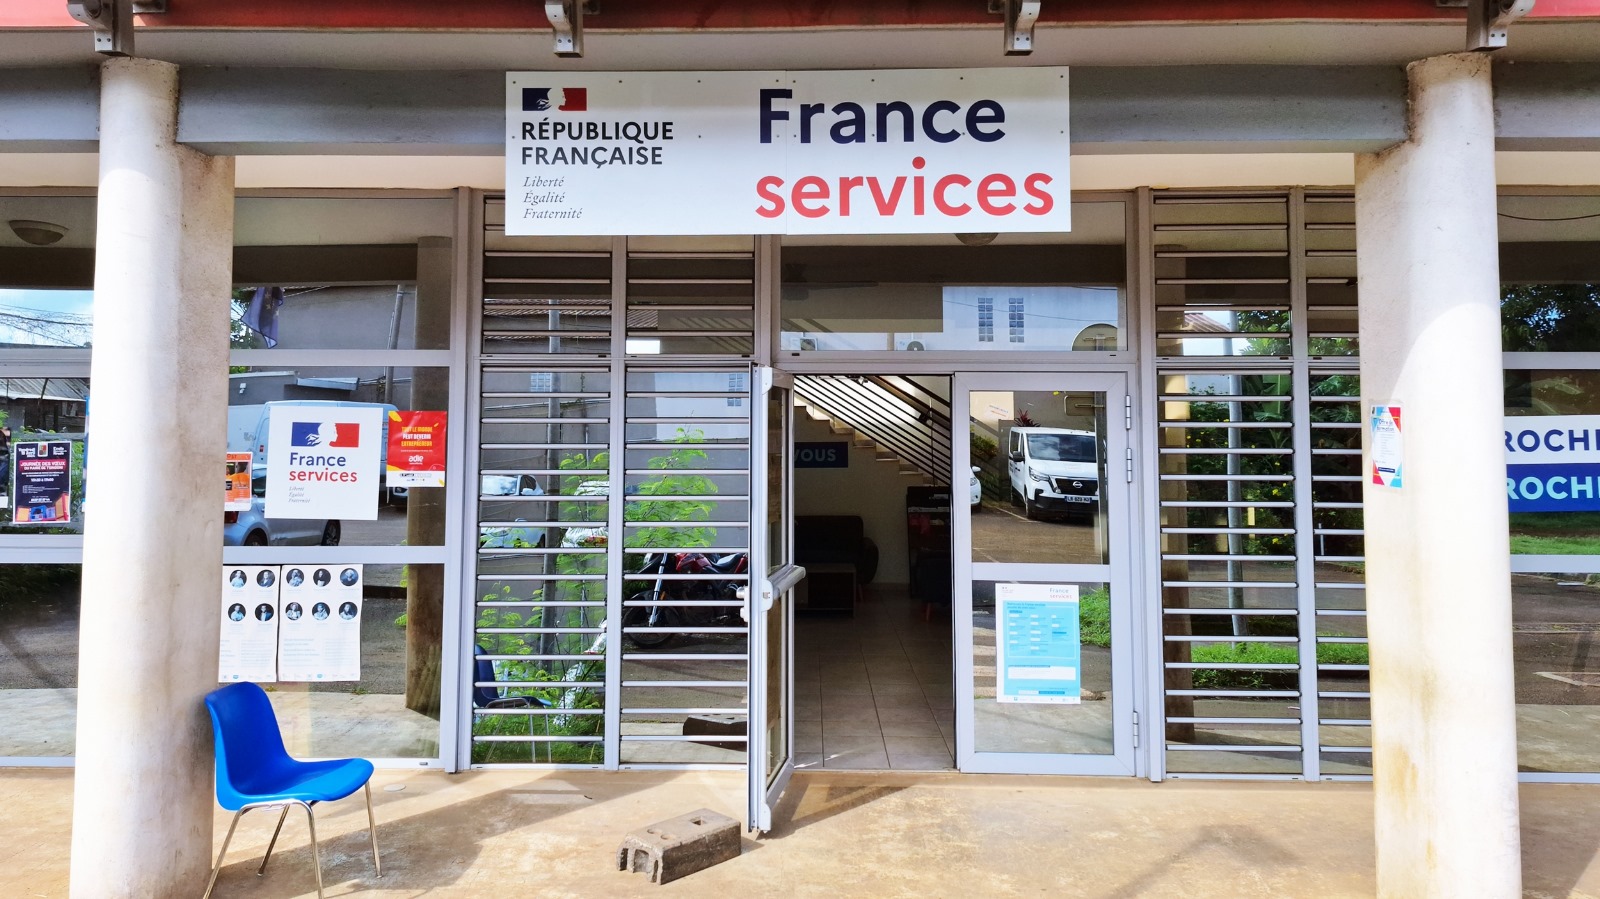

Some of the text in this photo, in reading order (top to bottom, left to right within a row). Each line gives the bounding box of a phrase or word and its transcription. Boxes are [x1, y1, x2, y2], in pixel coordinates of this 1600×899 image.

[759, 88, 1006, 144] France
[522, 117, 674, 144] RÉPUBLIQUE
[522, 147, 663, 169] FRANÇAISE
[523, 176, 565, 187] Liberté
[755, 156, 1054, 218] services
[523, 190, 566, 206] Égalité
[523, 208, 583, 219] Fraternité
[289, 452, 346, 467] France
[289, 467, 357, 482] services
[1507, 476, 1600, 500] ROCH
